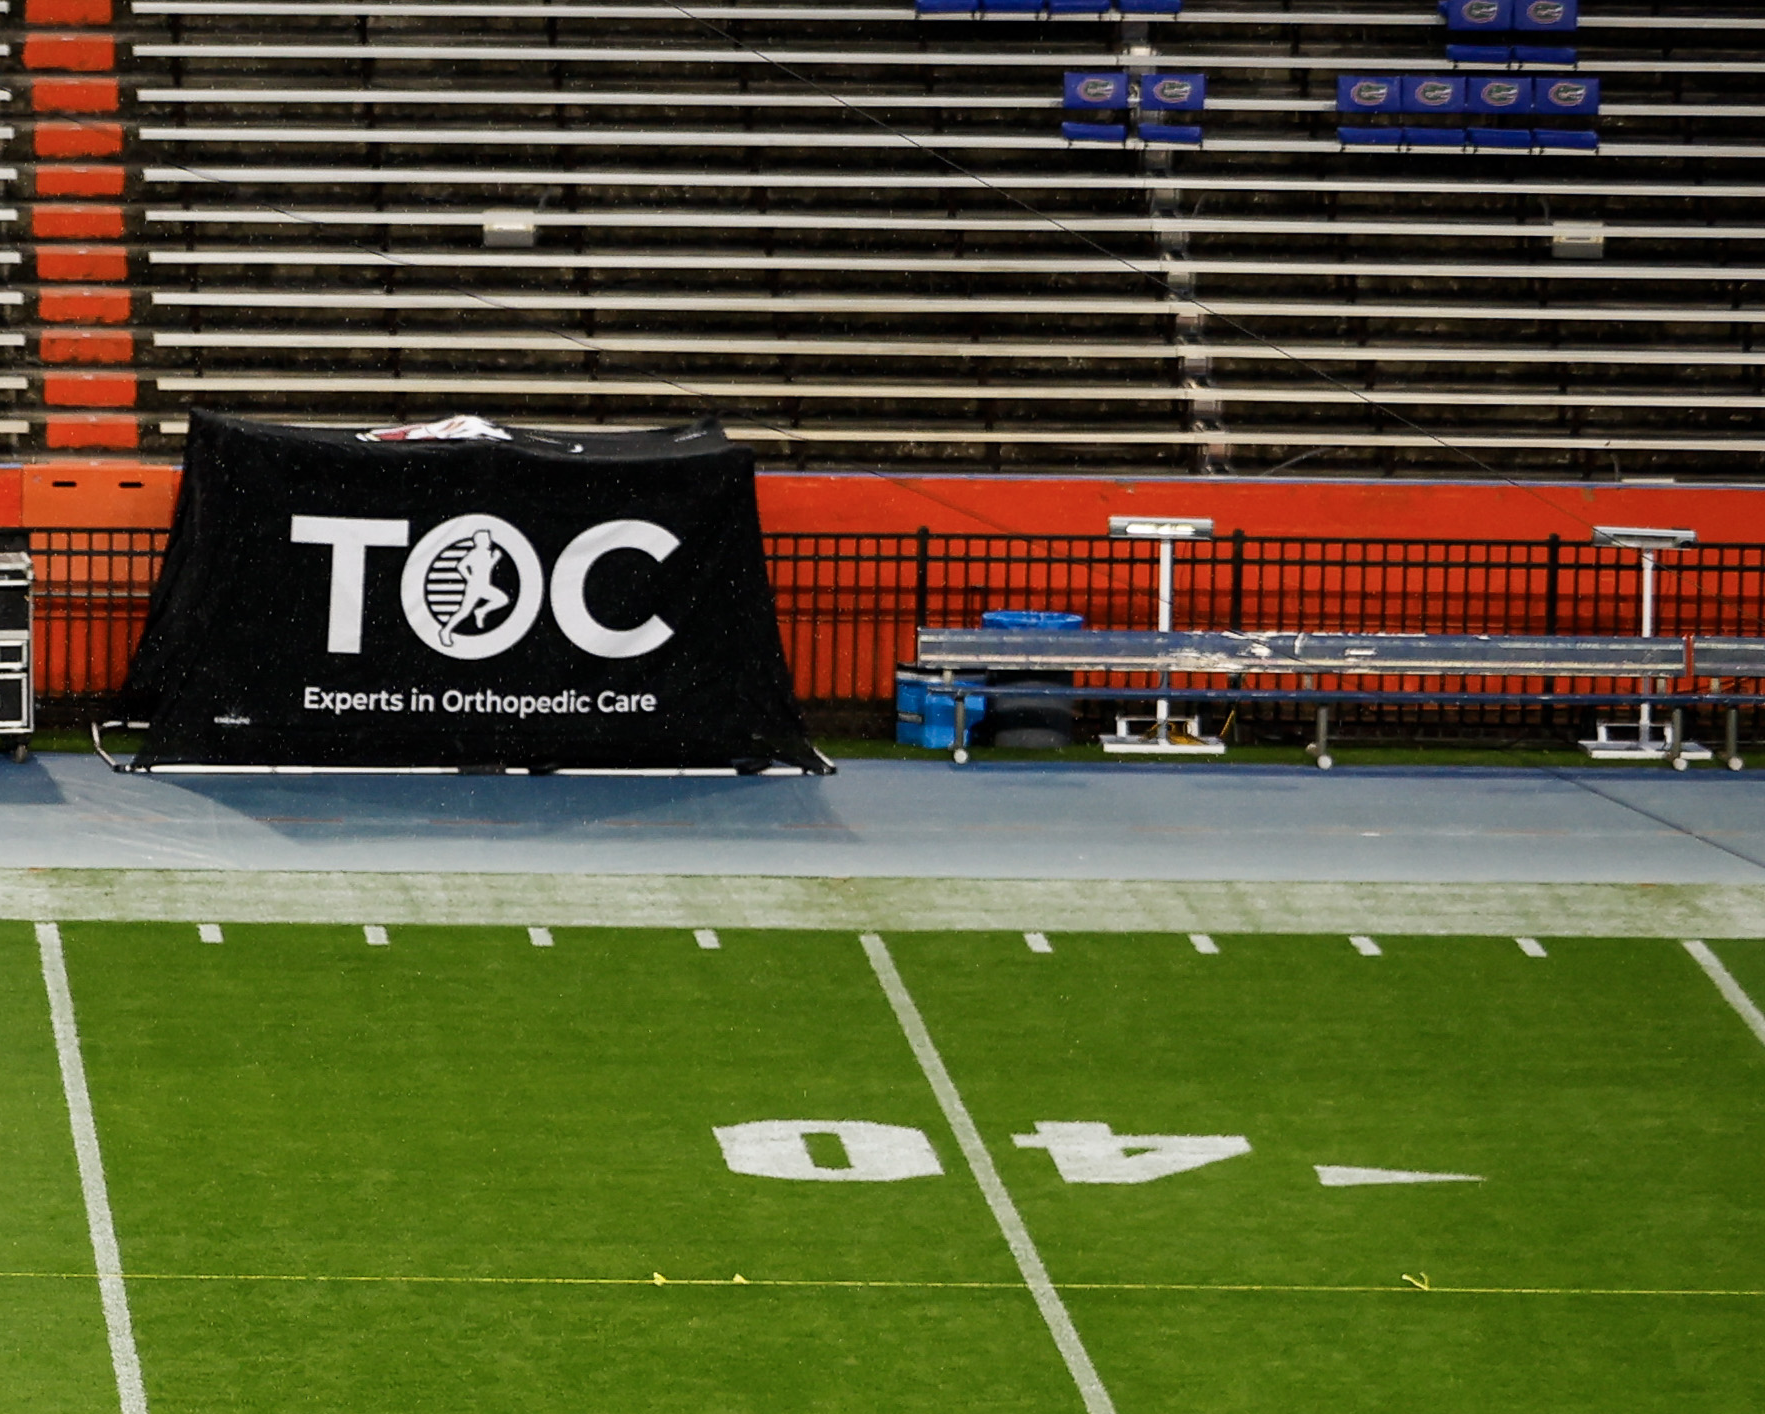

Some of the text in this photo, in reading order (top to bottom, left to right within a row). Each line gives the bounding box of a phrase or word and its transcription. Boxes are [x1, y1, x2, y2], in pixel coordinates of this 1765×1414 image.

[290, 513, 682, 661] TOC
[303, 687, 658, 719] Experts in Orthopedic Care
[711, 1119, 1253, 1185] 40
